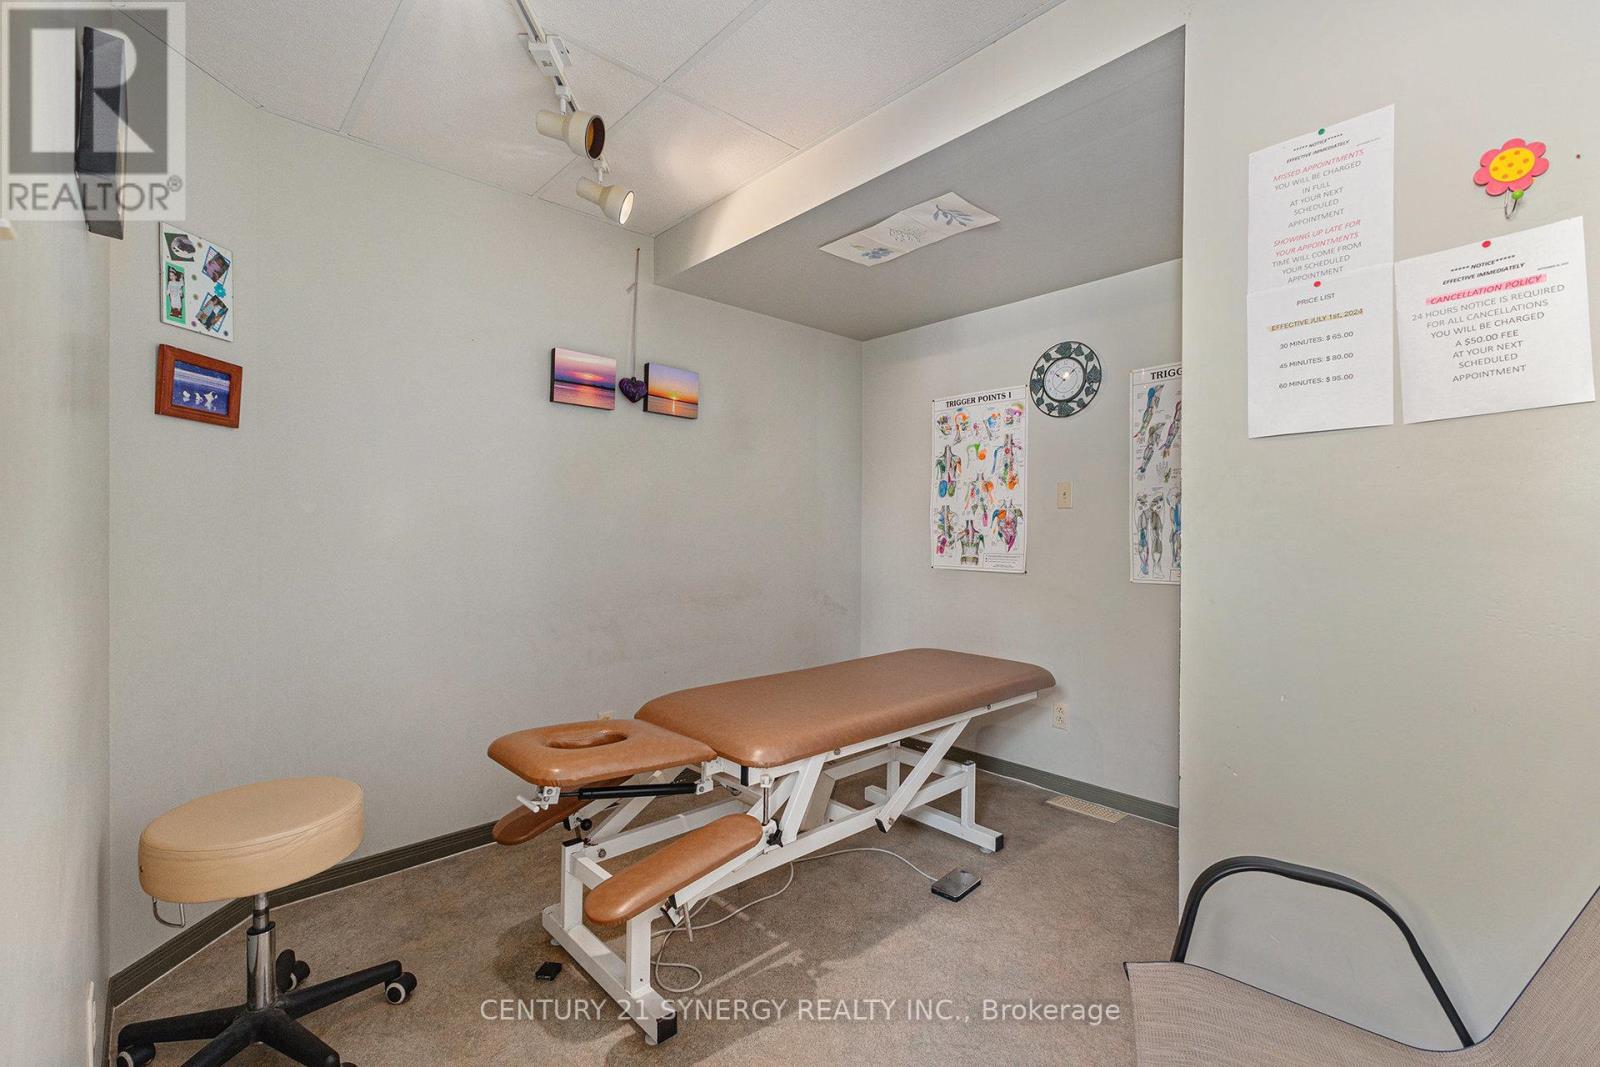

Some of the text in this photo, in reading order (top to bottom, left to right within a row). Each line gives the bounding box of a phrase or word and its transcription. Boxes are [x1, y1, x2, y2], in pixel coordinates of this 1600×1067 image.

[1273, 149, 1365, 182] MISSED APPOINTMENTS
[1275, 160, 1362, 192] YOU WILL BE CHARGED
[1289, 185, 1344, 208] AT YOUR NEXT
[1302, 181, 1331, 195] IN FULL
[1294, 198, 1339, 216] SCHEDULED
[1288, 208, 1345, 229] APPOINTMENT
[1273, 219, 1361, 248] SHOWING UP LATE FOR
[1272, 241, 1362, 268] TIME WILL COME FROM
[1275, 231, 1360, 258] YOUR APPOINTMENTS
[1282, 254, 1351, 275] YOUR SCHEDULED
[1287, 266, 1344, 284] APPOINTMENT
[1442, 273, 1476, 286] EFFECTIVE
[1476, 262, 1526, 278] IMMEDIATELY
[1296, 292, 1335, 307] PRICE LIST
[1430, 274, 1543, 305] CANCELLATION POLICY
[1411, 284, 1565, 322] 24 HOURS NOTICE IS REQUIRED
[1426, 298, 1550, 329] FOR ALL CANCELLATIONS
[1271, 318, 1310, 332] EFFECTIVE
[1310, 314, 1327, 324] JULY
[1344, 308, 1363, 318] 2024
[1430, 311, 1545, 339] YOU WILL BE CHARGED
[1289, 336, 1324, 348] MINUTES:
[1464, 333, 1498, 346] $50.00
[1500, 329, 1519, 339] FEE
[1289, 356, 1323, 368] MINUTES:
[1331, 352, 1354, 361] 80.00
[1452, 340, 1524, 359] AT YOUR NEXT
[1458, 353, 1518, 369] SCHEDULED
[1278, 382, 1288, 390] 60
[1288, 377, 1324, 388] MINUTES:
[1331, 373, 1354, 382] 95.00
[1452, 364, 1527, 383] APPOINTMENT
[945, 396, 976, 408] TRIGGER
[977, 392, 1006, 403] POINTS
